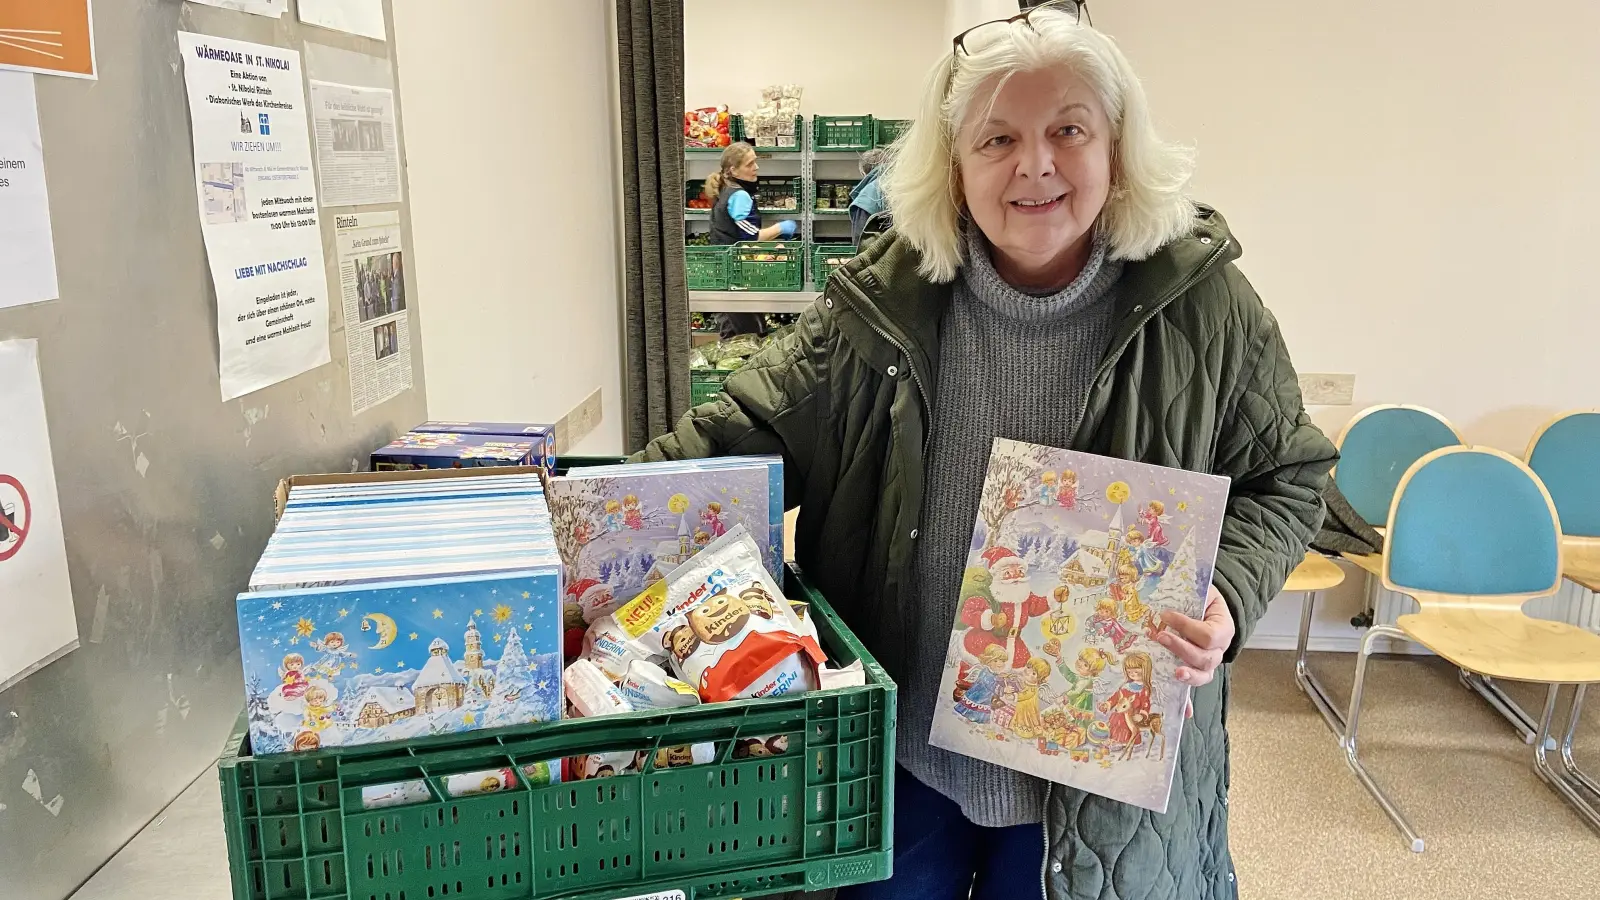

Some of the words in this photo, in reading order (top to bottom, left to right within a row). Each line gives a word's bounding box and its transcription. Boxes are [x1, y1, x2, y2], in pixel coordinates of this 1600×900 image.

[196, 44, 243, 64] WÄRMEOASE
[245, 54, 253, 65] IN
[256, 56, 264, 67] ST.
[230, 70, 241, 79] Eine
[242, 71, 259, 81] Aktion
[238, 84, 256, 94] Nikolai
[256, 86, 272, 95] Rinteln
[209, 95, 241, 105] Diakonisches
[242, 98, 254, 106] Werk
[263, 100, 292, 110] Kirchenkreises
[231, 141, 244, 152] WIR
[244, 142, 265, 152] ZIEHEN
[266, 141, 282, 152] UM!!!
[261, 198, 274, 207] jeden
[274, 196, 294, 205] Mittwoch
[252, 210, 278, 219] kostenlosen
[297, 207, 315, 215] Mahlzeit
[336, 216, 358, 228] Rinteln
[235, 266, 254, 279] LIEBE
[255, 264, 266, 275] MIT
[266, 257, 307, 273] NACHSCHLAG
[256, 293, 280, 305] Eingeladen
[286, 289, 298, 298] jeder,
[246, 311, 255, 320] sich
[256, 308, 267, 317] über
[280, 302, 296, 312] schönen
[266, 313, 294, 327] Gemeinschaft
[245, 336, 256, 345] und
[256, 334, 266, 342] eine
[267, 331, 282, 339] warme
[282, 324, 300, 335] Mahlzeit
[625, 594, 655, 626] NEU!!
[704, 606, 743, 634] Kinder
[751, 680, 777, 698] Kinder
